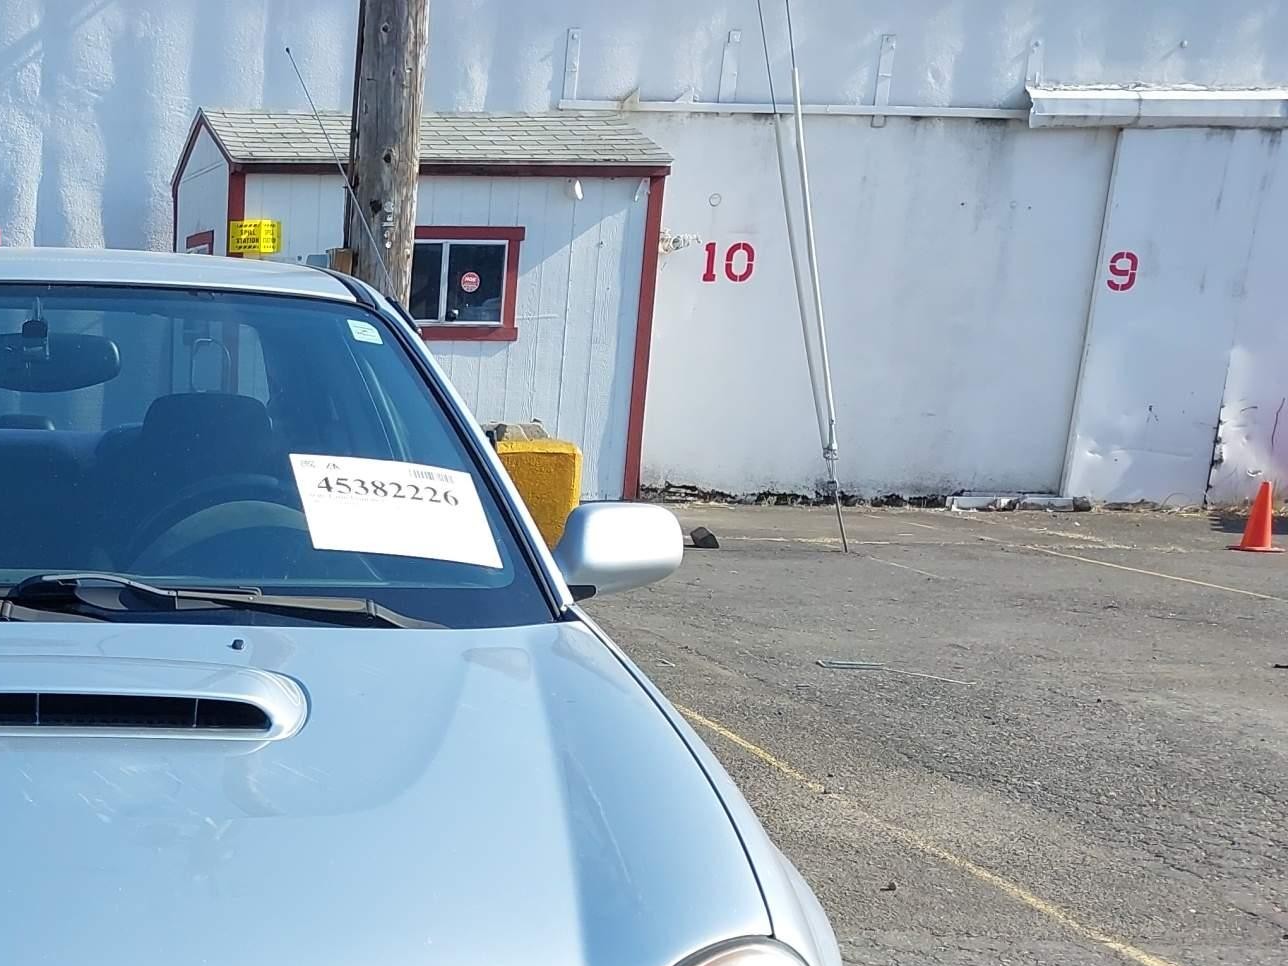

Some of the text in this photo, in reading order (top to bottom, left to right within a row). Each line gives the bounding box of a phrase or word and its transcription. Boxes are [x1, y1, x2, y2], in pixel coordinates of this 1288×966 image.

[702, 242, 755, 282] 10
[1107, 251, 1139, 292] 9
[317, 476, 460, 507] 45382226
